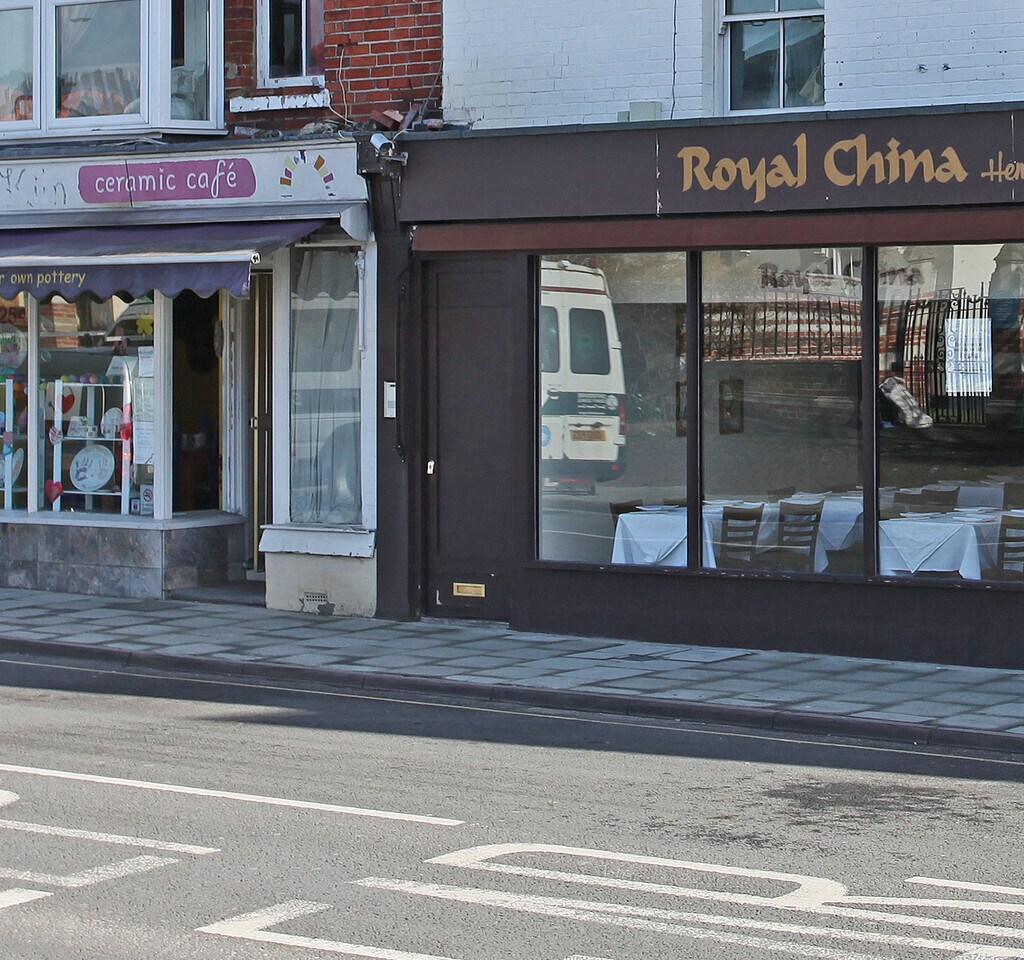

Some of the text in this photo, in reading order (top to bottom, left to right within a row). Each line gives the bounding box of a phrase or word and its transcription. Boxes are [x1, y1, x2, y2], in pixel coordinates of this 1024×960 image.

[95, 160, 237, 198] ceramic café
[677, 133, 806, 203] Royal
[823, 134, 969, 186] China
[10, 274, 33, 284] own
[37, 271, 86, 287] pottery
